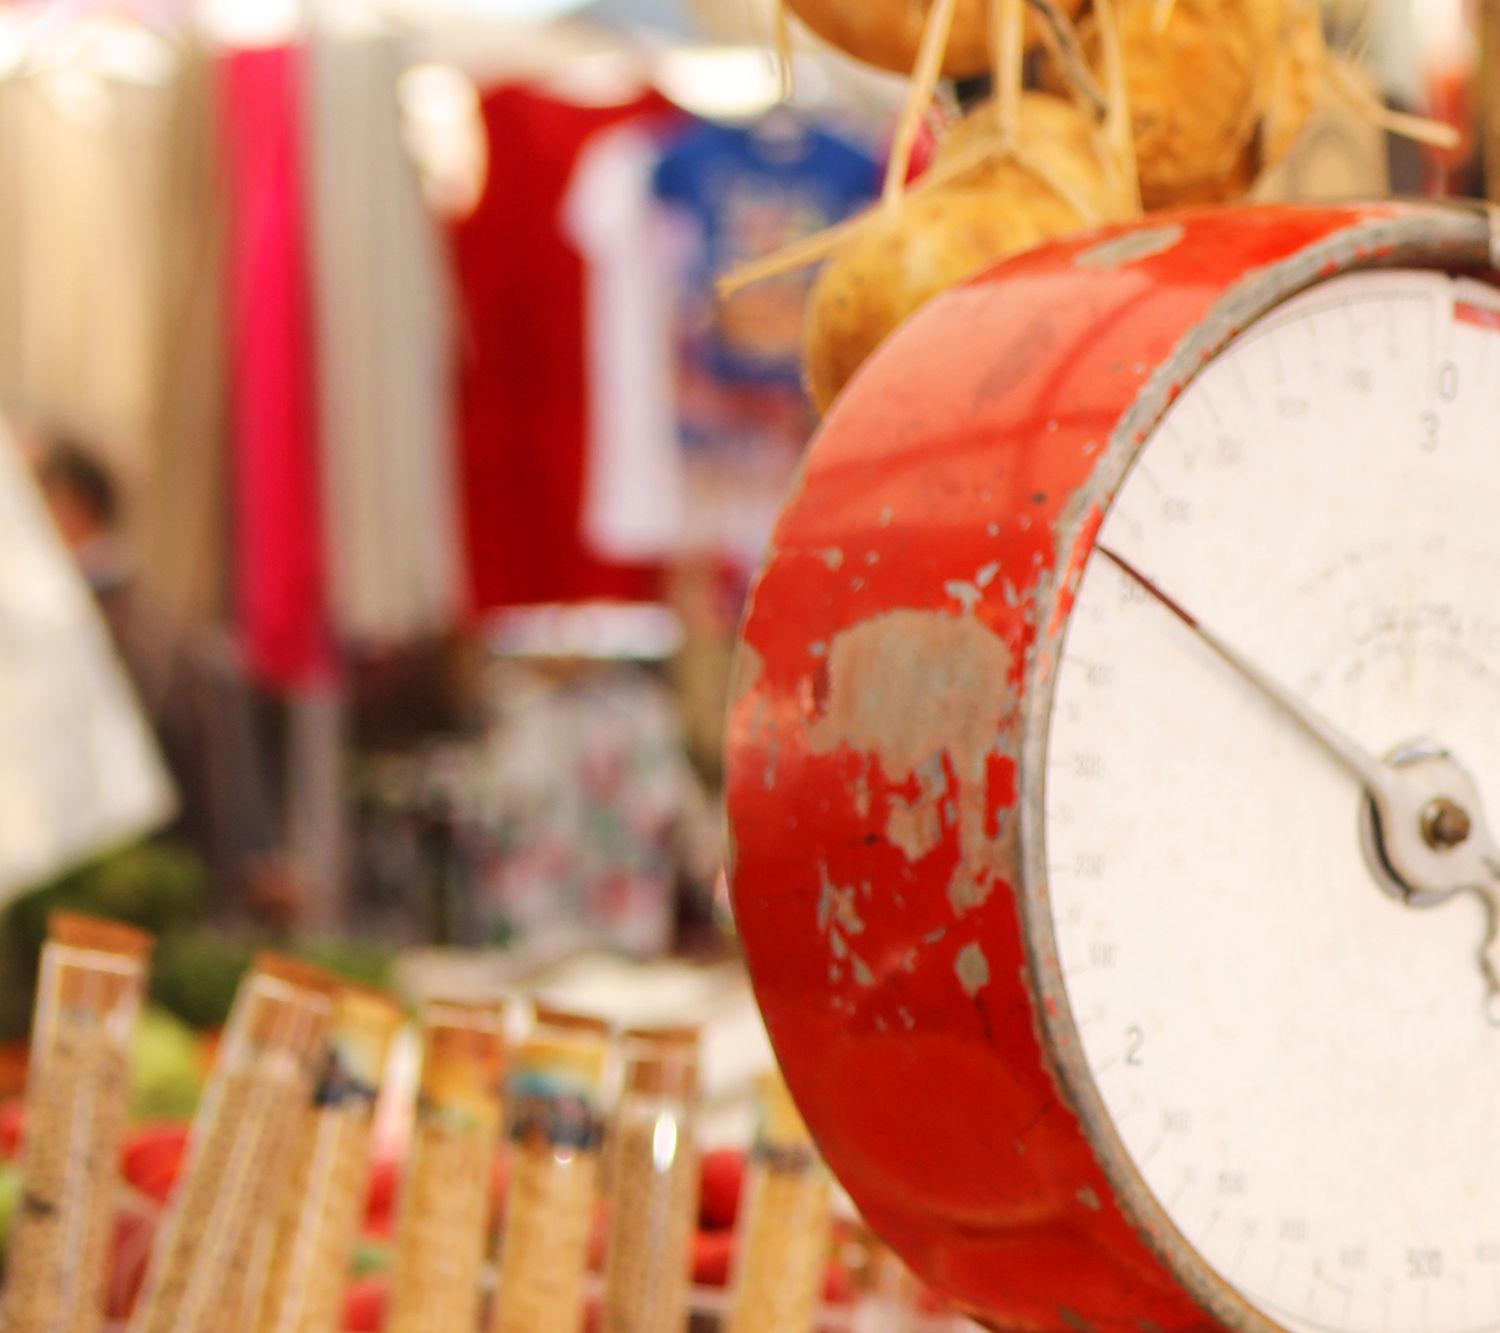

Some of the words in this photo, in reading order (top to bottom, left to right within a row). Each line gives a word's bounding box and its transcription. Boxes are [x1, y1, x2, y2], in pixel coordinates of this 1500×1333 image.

[1438, 360, 1459, 404] 0
[1419, 410, 1440, 454] 3
[1124, 1023, 1146, 1067] 2
